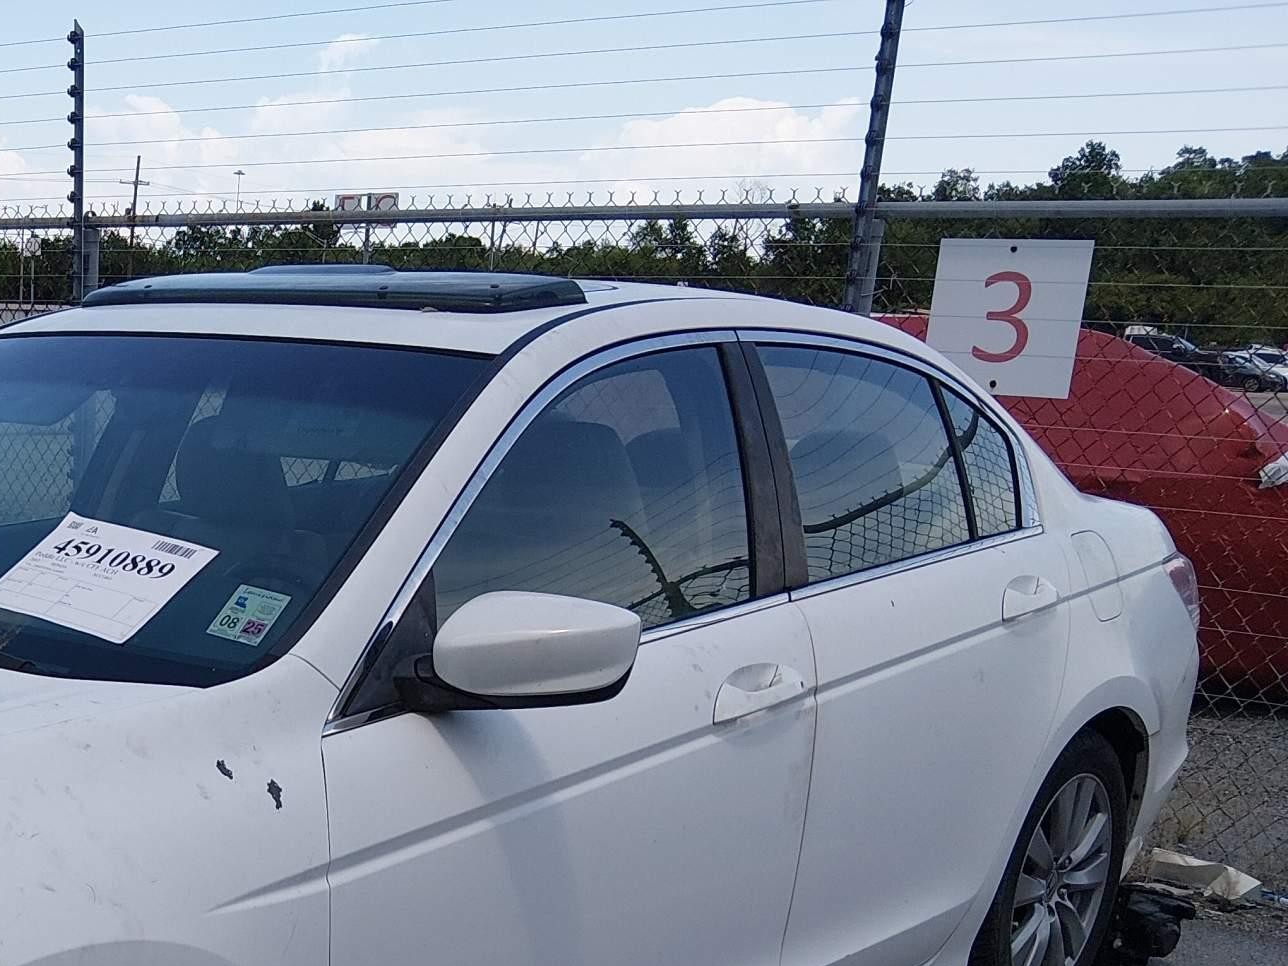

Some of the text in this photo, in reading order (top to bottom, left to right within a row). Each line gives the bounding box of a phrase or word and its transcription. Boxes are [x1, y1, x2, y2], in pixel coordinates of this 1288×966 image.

[971, 270, 1032, 363] 3
[53, 537, 176, 579] 45910889
[219, 614, 240, 629] 08
[242, 620, 265, 635] 25
